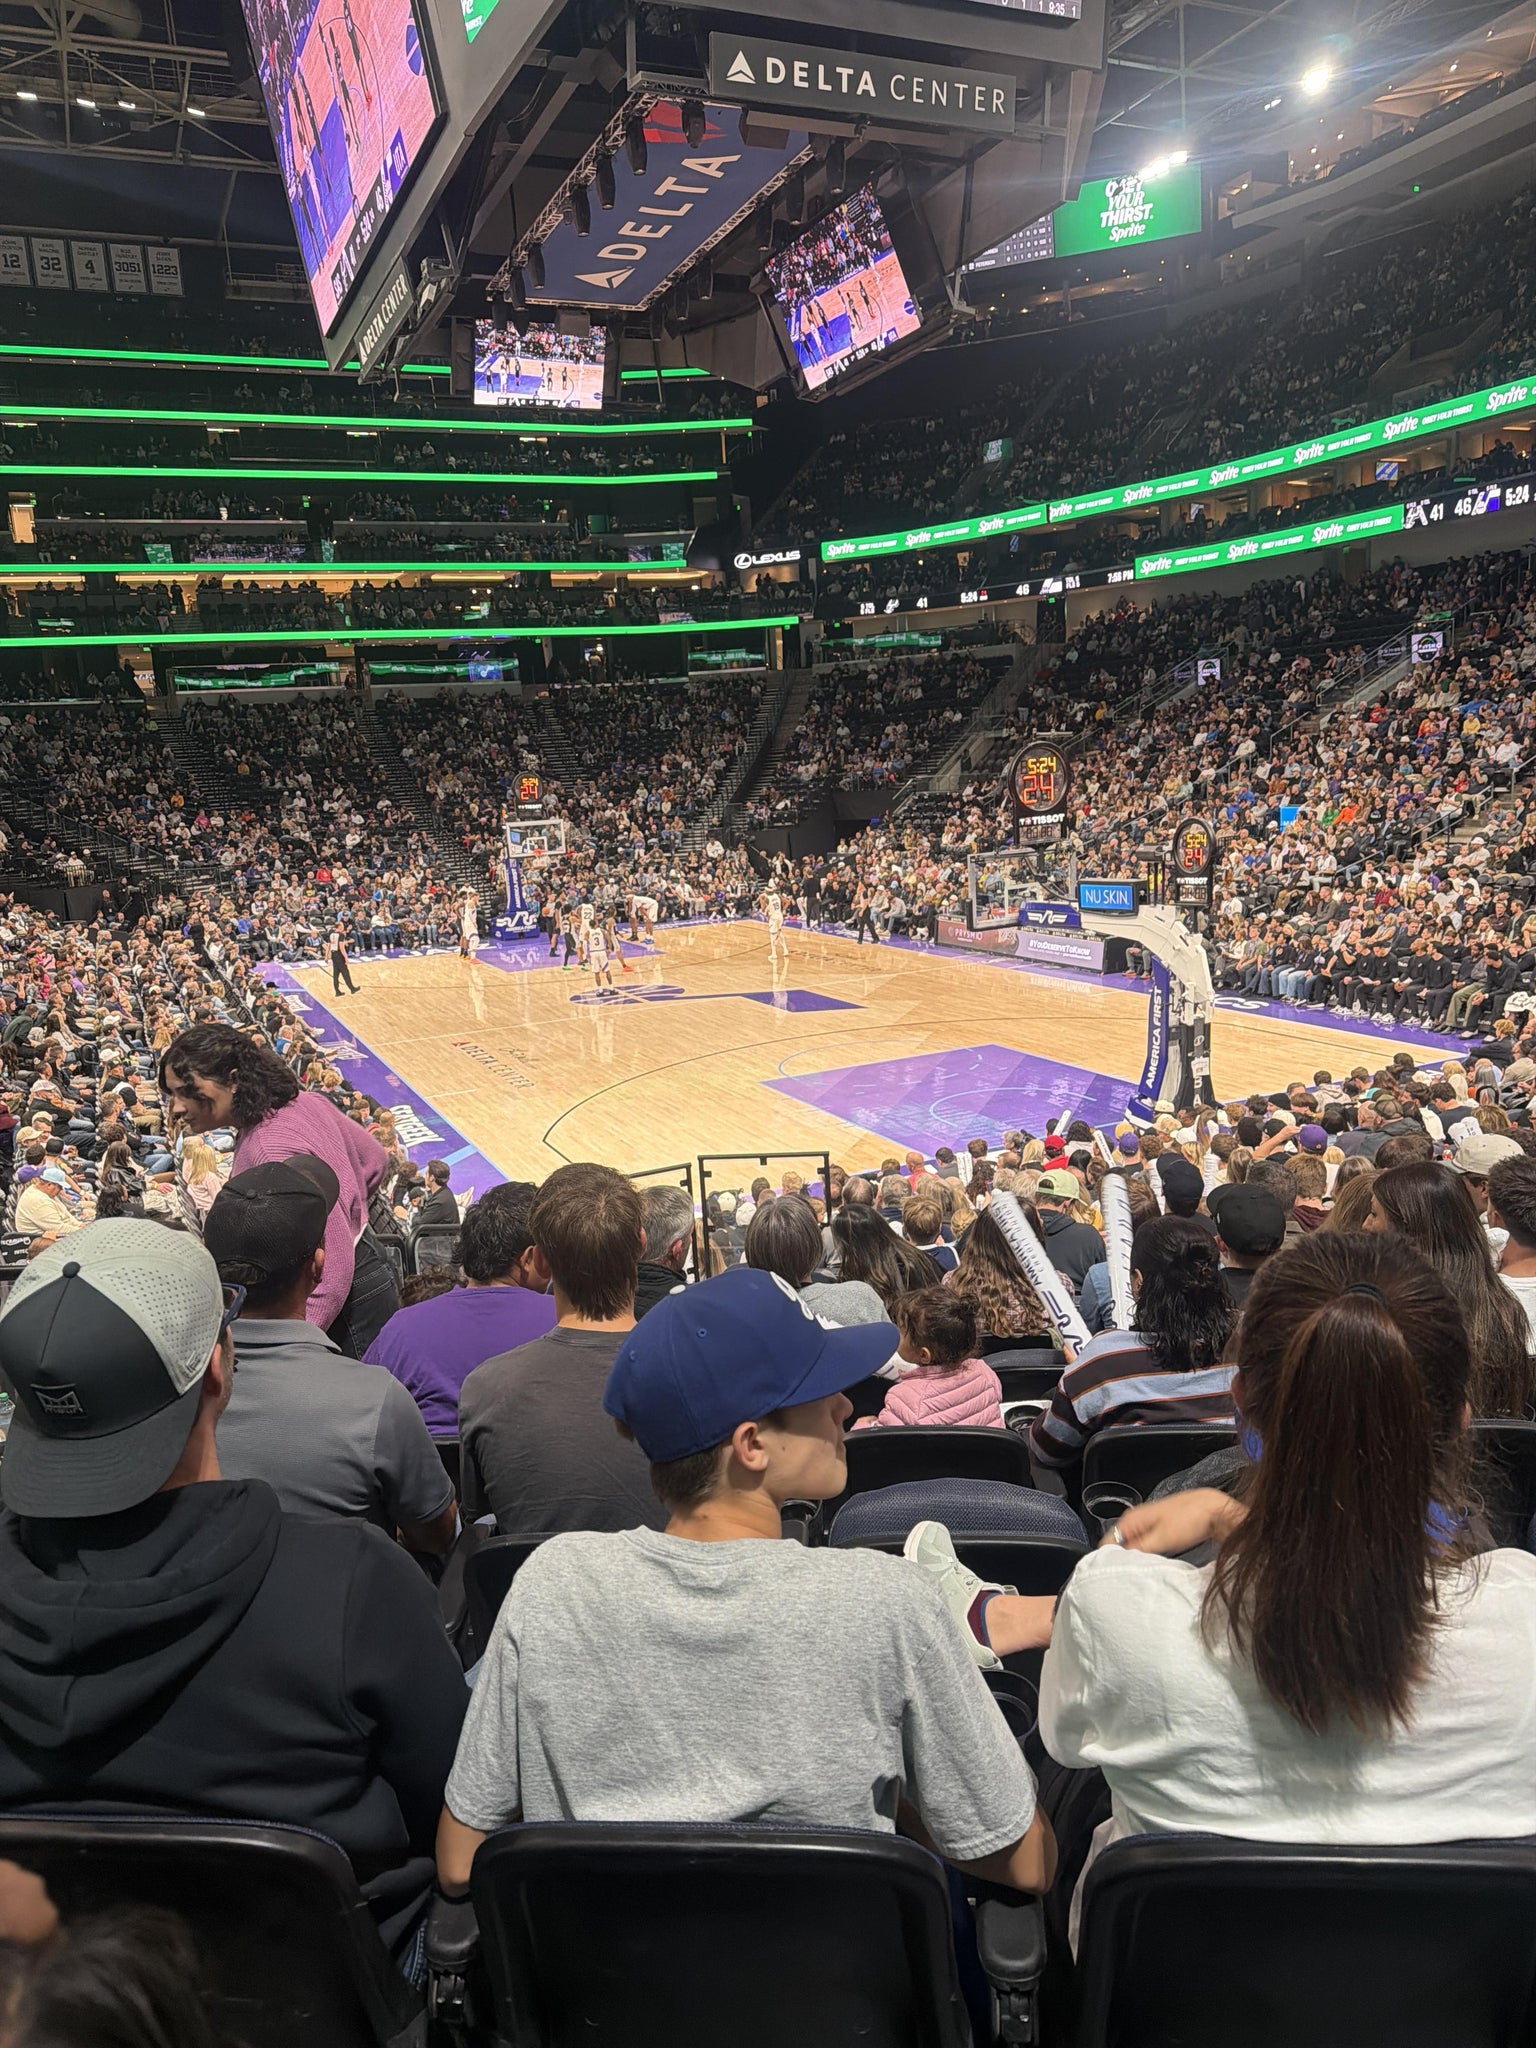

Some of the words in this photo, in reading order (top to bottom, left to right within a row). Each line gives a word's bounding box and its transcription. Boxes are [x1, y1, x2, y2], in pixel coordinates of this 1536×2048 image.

[1048, 1, 1065, 16] 9:35
[766, 57, 876, 98] DELTA
[890, 74, 1005, 115] CENTER
[597, 153, 742, 261] DELTA
[1108, 191, 1145, 211] YOUR
[1109, 222, 1146, 243] Sprite
[2, 253, 21, 269] 12
[40, 257, 62, 272] 32
[85, 260, 95, 274] 4
[114, 261, 142, 273] 3051
[152, 263, 178, 276] 1223
[363, 314, 385, 355] DELTA
[382, 273, 408, 325] CENTER
[1486, 385, 1528, 412] Sprite
[1382, 416, 1419, 440] Sprite
[1293, 443, 1324, 464] Sprite
[1209, 466, 1239, 486] Sprite
[1122, 485, 1153, 504] Sprite
[1430, 503, 1444, 521] 41
[1454, 498, 1472, 516] 46
[1505, 484, 1530, 507] 5:24
[977, 517, 1004, 534] Sprite
[1312, 523, 1344, 544] Sprite
[905, 530, 932, 547] Sprite
[752, 550, 801, 565] LEXUS
[826, 542, 856, 558] Sprite
[1226, 541, 1258, 560] Sprite
[1139, 556, 1172, 575] Sprite
[916, 597, 928, 609] 41
[1027, 756, 1057, 775] 5:24
[520, 785, 538, 801] 24
[1021, 773, 1054, 806] 24
[1031, 812, 1066, 825] TISSOT
[1186, 833, 1207, 849] 5:24
[1184, 848, 1204, 868] 24
[1085, 889, 1101, 904] NU
[1103, 889, 1131, 906] SKIN
[583, 911, 592, 920] 22
[593, 937, 600, 946] 3
[1152, 985, 1163, 1026] FIRST
[460, 1045, 498, 1066] DELTA
[488, 1064, 535, 1089] CENTER
[1145, 1026, 1162, 1089] AMERICA
